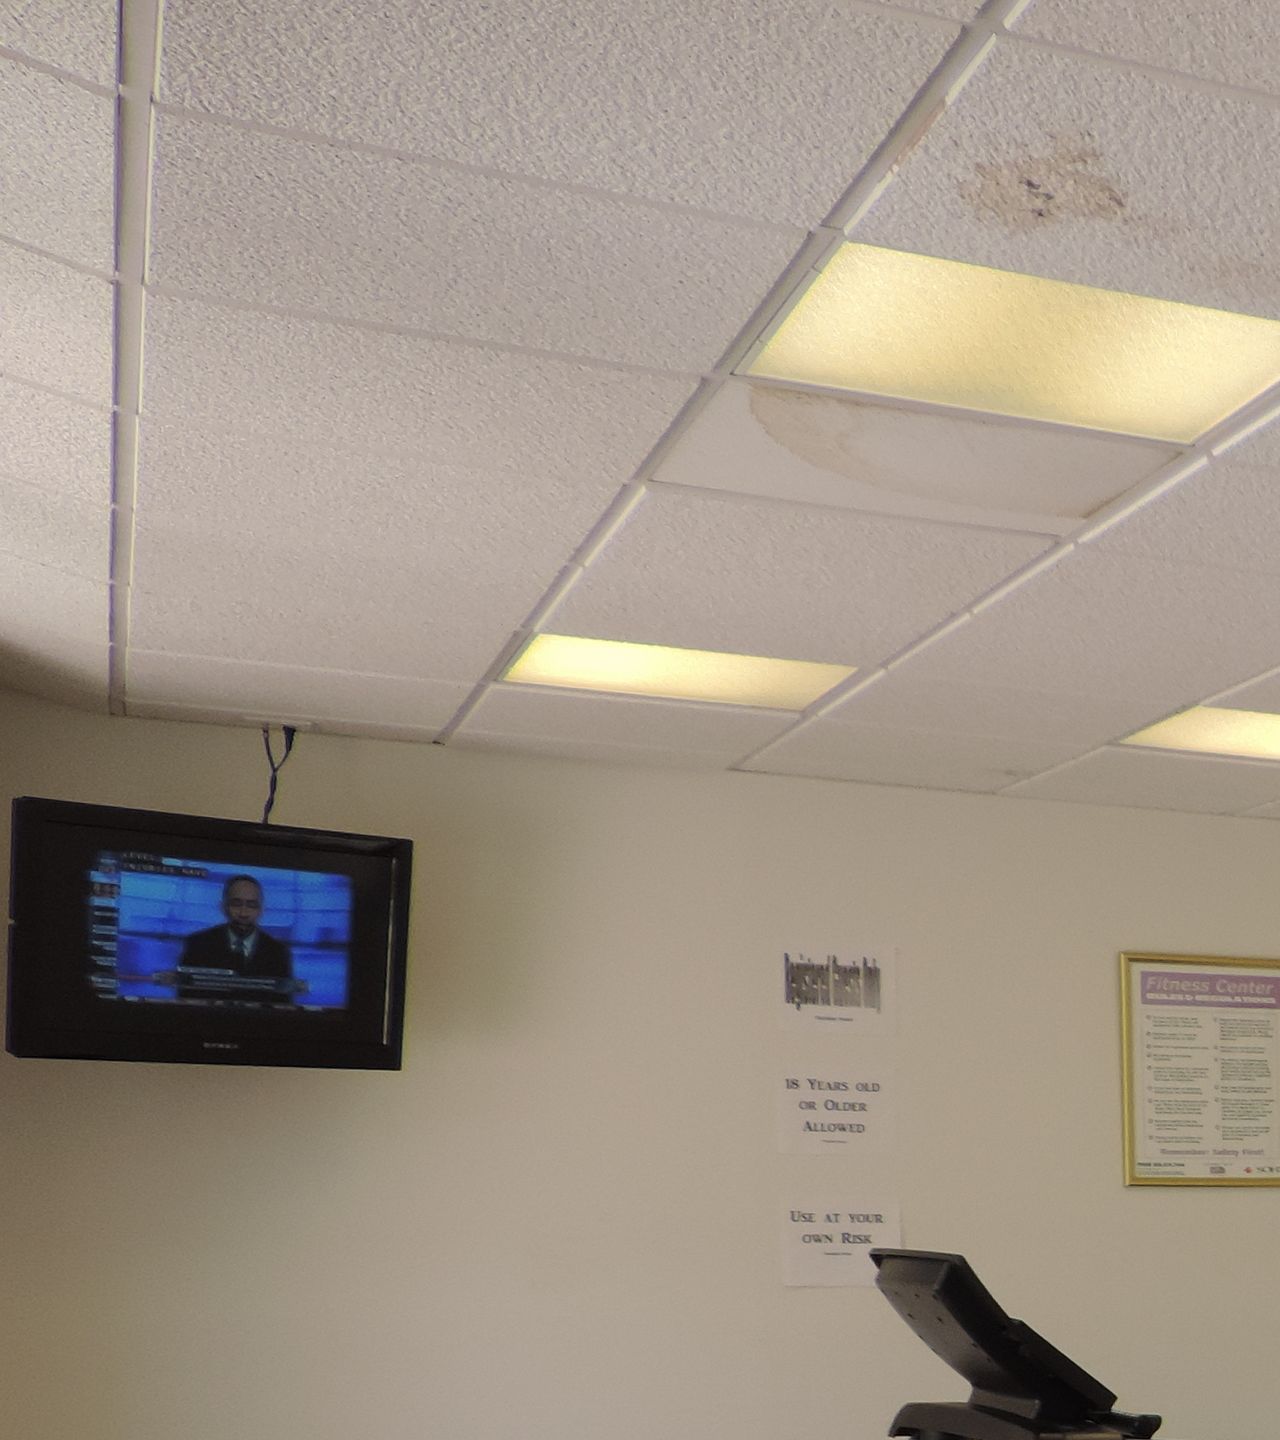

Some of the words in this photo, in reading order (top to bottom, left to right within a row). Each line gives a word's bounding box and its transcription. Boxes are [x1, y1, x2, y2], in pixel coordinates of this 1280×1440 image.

[1146, 976, 1210, 993] Fitness
[1215, 979, 1275, 995] Center
[785, 1078, 800, 1090] 18
[790, 1210, 816, 1223] USE
[841, 1232, 873, 1244] RISK
